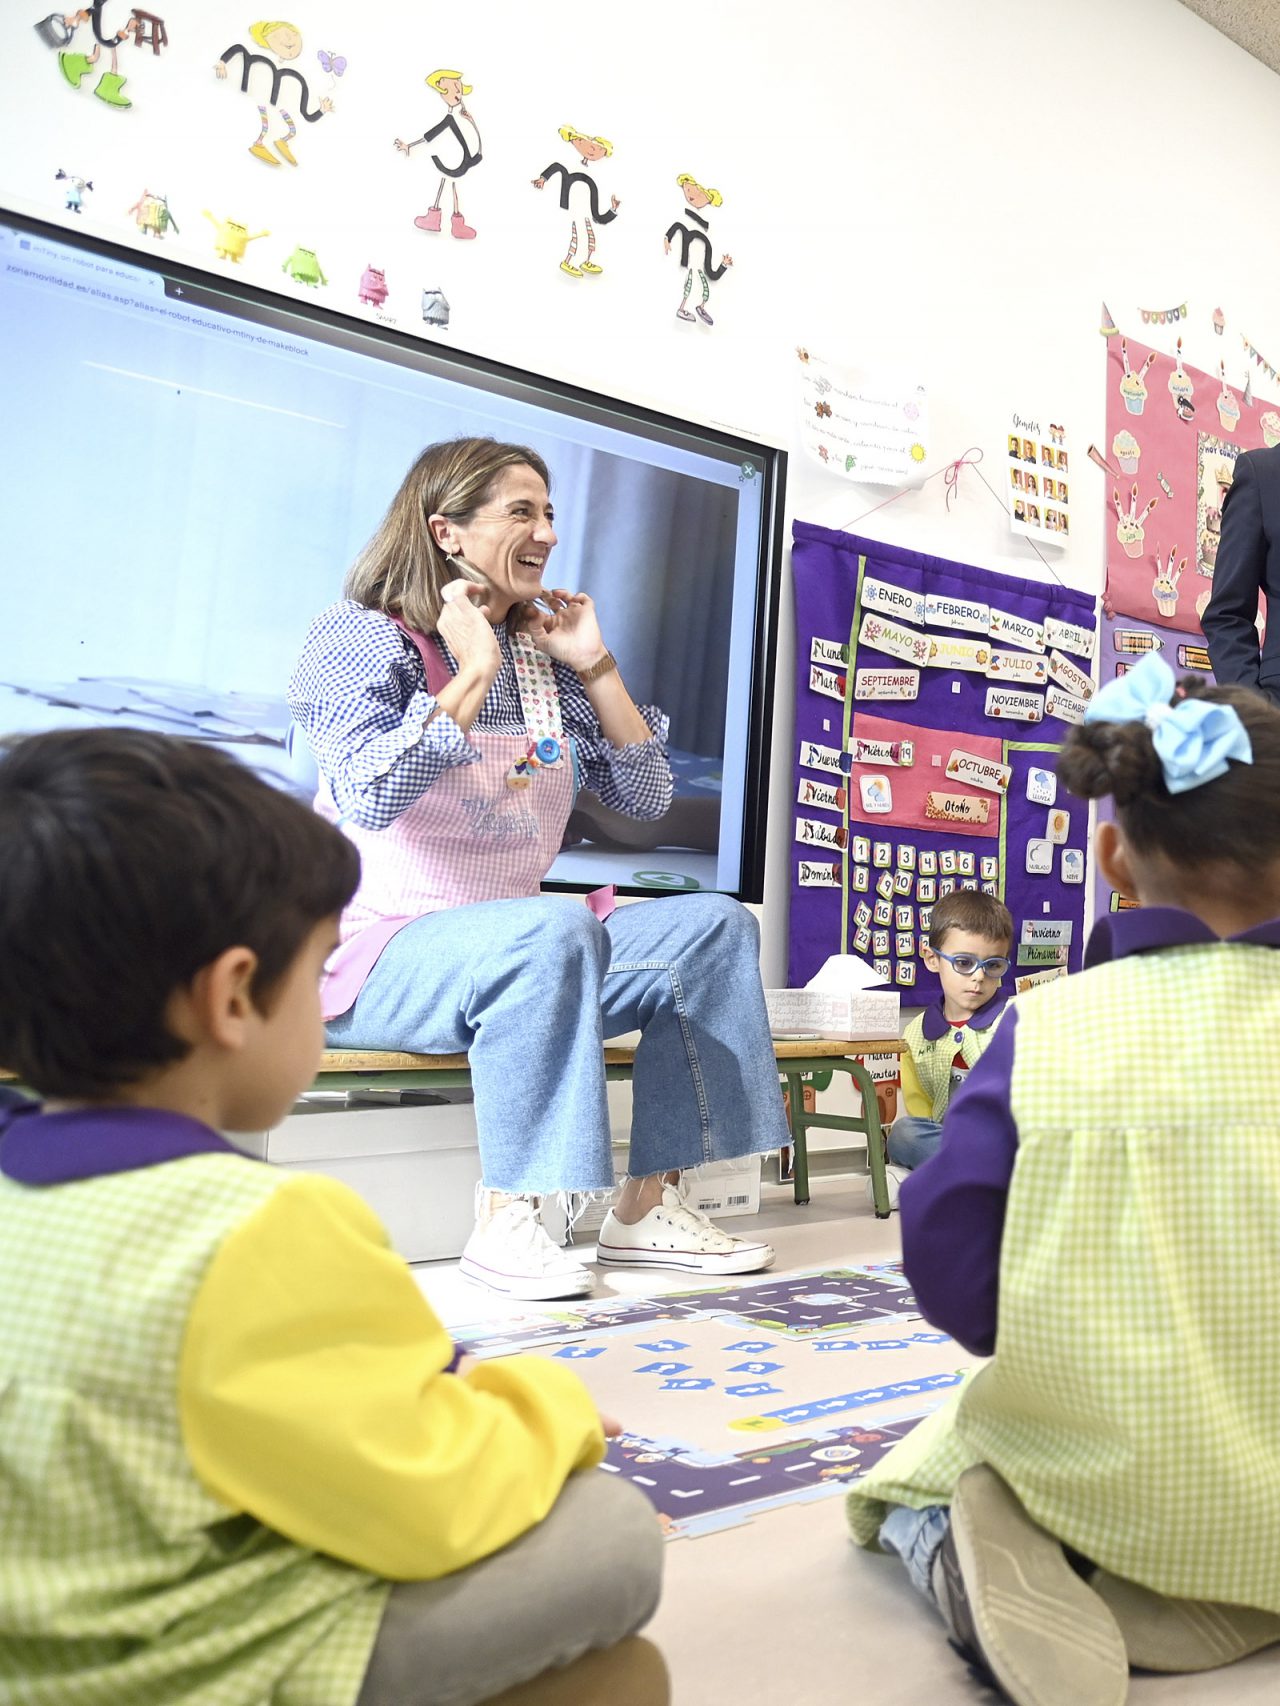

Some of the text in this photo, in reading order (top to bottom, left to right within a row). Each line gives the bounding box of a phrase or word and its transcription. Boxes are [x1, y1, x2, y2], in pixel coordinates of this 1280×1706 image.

[1205, 446, 1218, 455] HOY
[878, 588, 912, 608] ENERO
[936, 602, 980, 620] FEBRERO
[1001, 619, 1034, 638] MARZO
[882, 627, 913, 647] MAYO
[1059, 629, 1082, 644] ABRIL
[940, 643, 974, 658] JUNIO
[1002, 657, 1033, 670] JULIO
[861, 676, 915, 686] SEPTIEMBRE
[1058, 663, 1087, 690] AGOSTO
[991, 695, 1040, 710] NOVIEMBRE
[818, 752, 842, 768] Jueve
[901, 747, 911, 759] 19
[959, 758, 1001, 780] OCTUBRE
[1033, 794, 1051, 802] LLUVIA
[859, 843, 993, 874] 1 2 3 4 5 6 7
[858, 873, 864, 885] 8
[885, 880, 892, 892] 9
[896, 875, 908, 889] 10
[921, 885, 929, 896] 11
[942, 884, 952, 895] 12
[858, 908, 868, 923] 15
[877, 906, 888, 919] 16
[899, 911, 910, 923] 17
[857, 931, 869, 944] 22
[876, 936, 887, 947] 23
[899, 937, 911, 948] 24
[1027, 947, 1060, 960] Primavera
[901, 967, 911, 979] 31
[867, 1070, 897, 1081] ienstag
